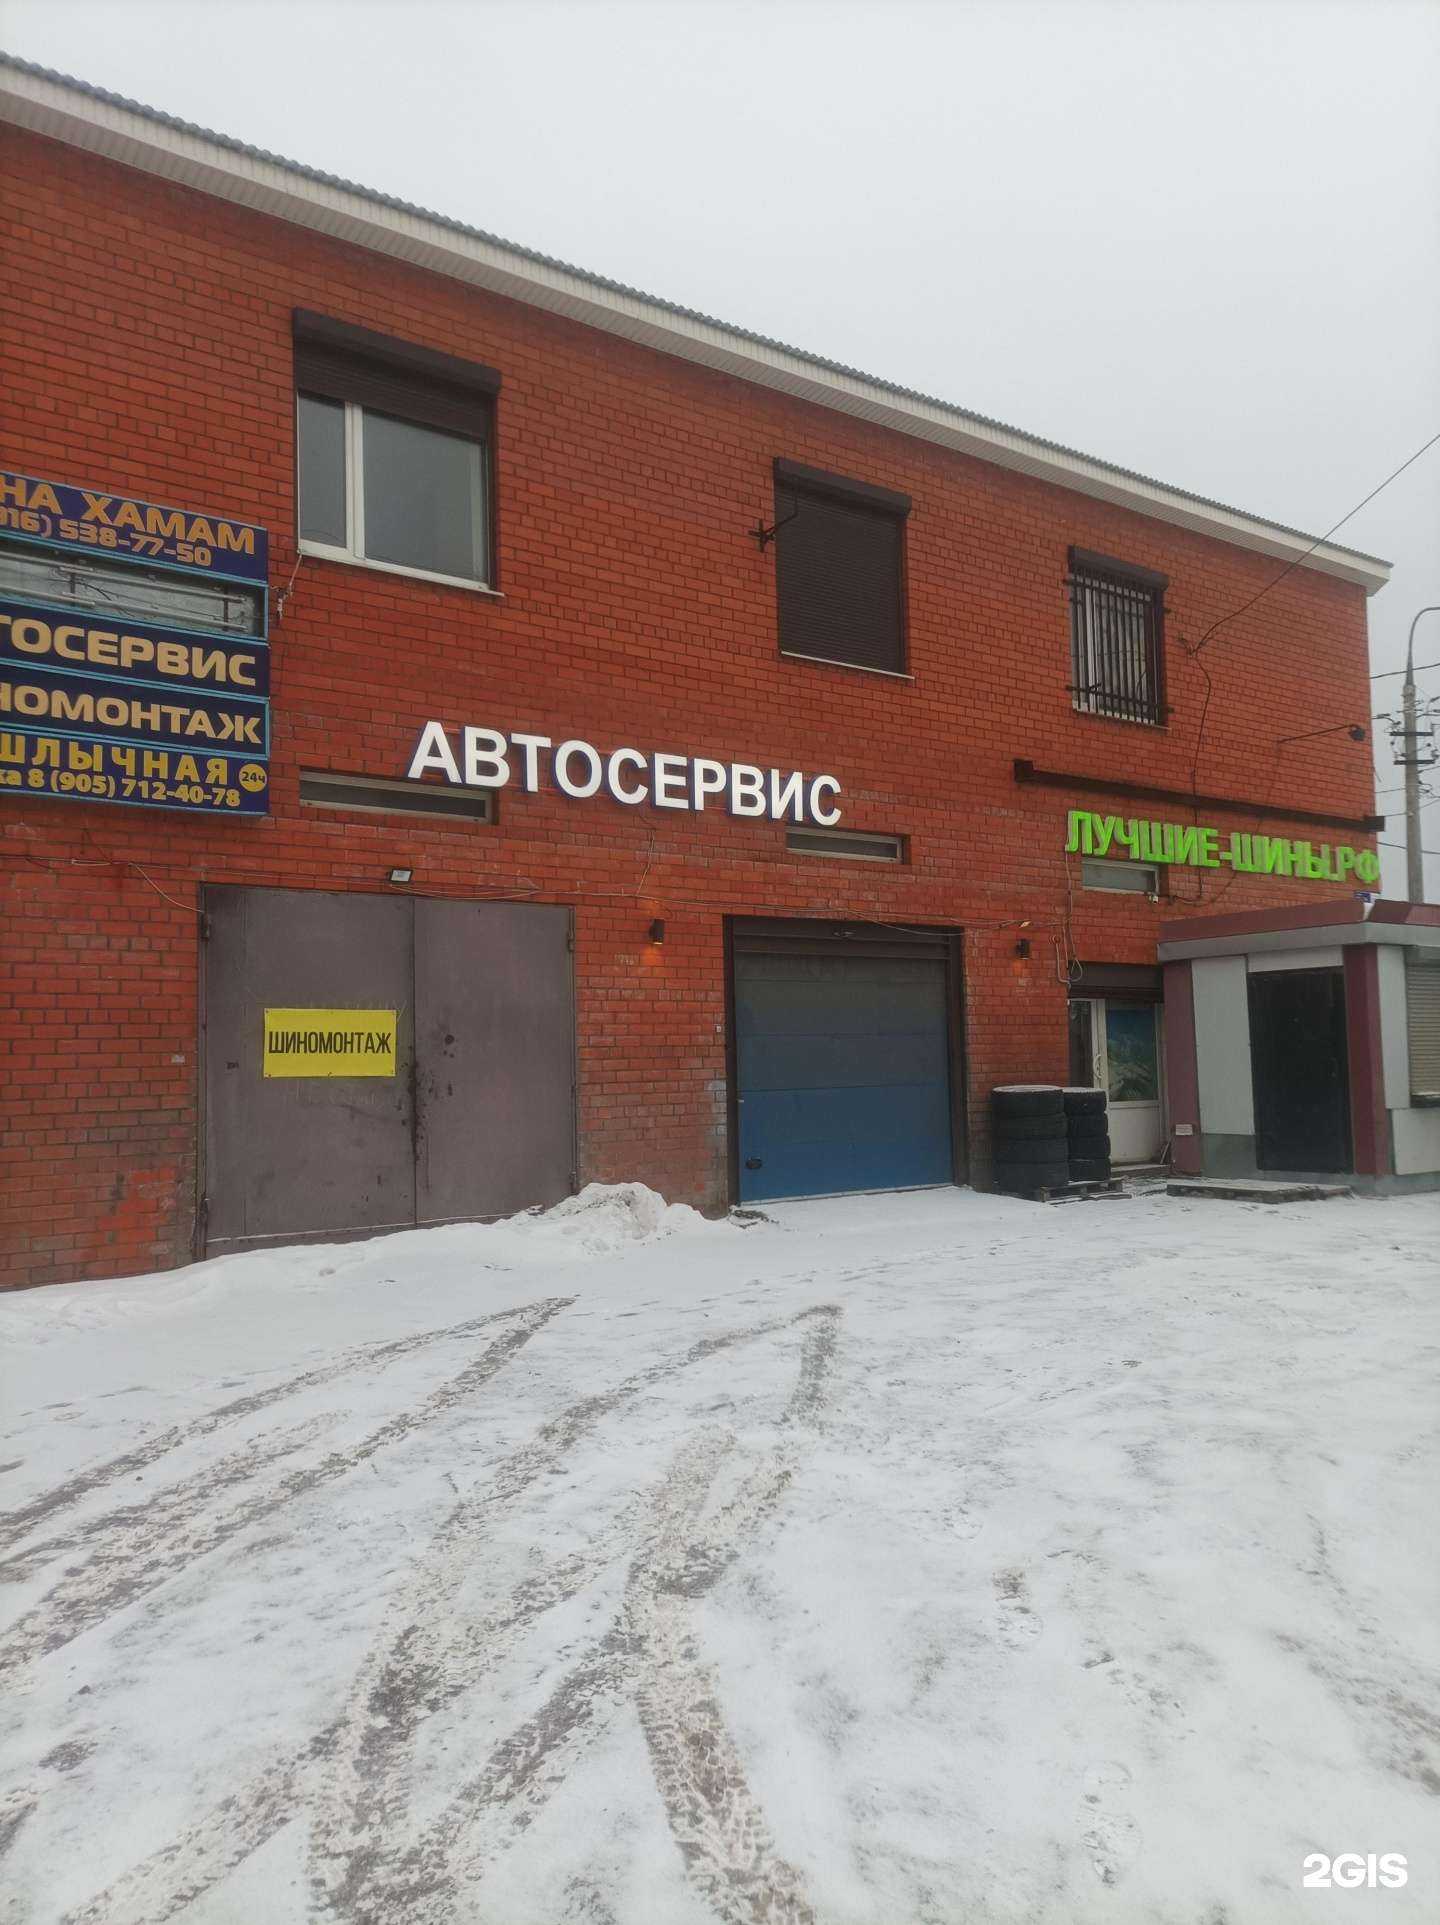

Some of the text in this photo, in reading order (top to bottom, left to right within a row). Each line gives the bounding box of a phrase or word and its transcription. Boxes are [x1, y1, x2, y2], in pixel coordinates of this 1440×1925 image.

[59, 518, 213, 567] 538-77-50
[81, 491, 256, 555] ХАМАМ
[27, 768, 46, 789] 8
[50, 769, 117, 799] (905)
[121, 778, 242, 808] 712-40-78
[406, 720, 843, 827] АВТОСЕРВИС
[1065, 810, 1380, 885] ЛУЧШИЕ-ШИНЫ.РФ
[268, 1031, 392, 1055] ШИНОМОНТАЖ
